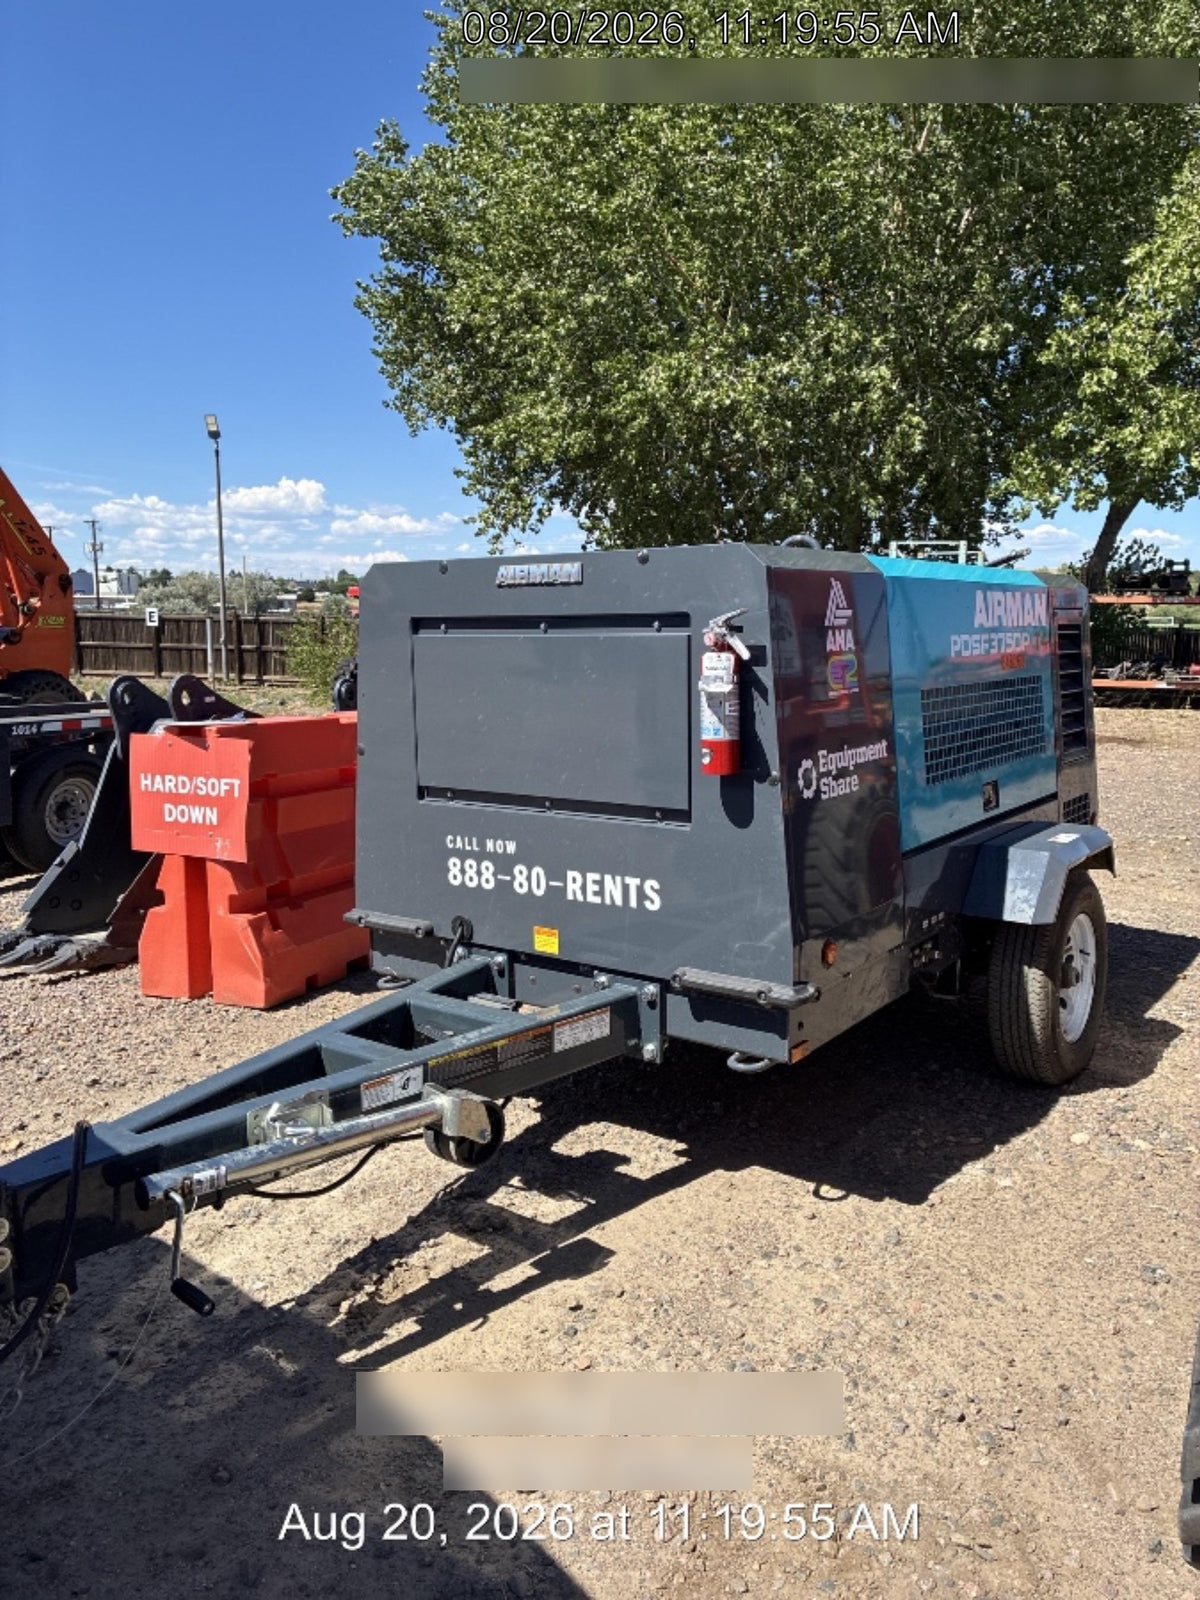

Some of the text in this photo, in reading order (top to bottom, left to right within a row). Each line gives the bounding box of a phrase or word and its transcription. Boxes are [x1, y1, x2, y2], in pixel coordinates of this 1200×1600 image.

[148, 611, 157, 623] E
[973, 589, 1048, 628] AIRMAN
[826, 629, 856, 652] ANA
[817, 739, 888, 775] Equipment
[139, 772, 241, 798] HARD/SOFT
[820, 774, 859, 800] Share
[163, 803, 218, 826] DOWN
[446, 835, 517, 855] CALL NOW
[447, 857, 662, 912] 888-80-RENTS
